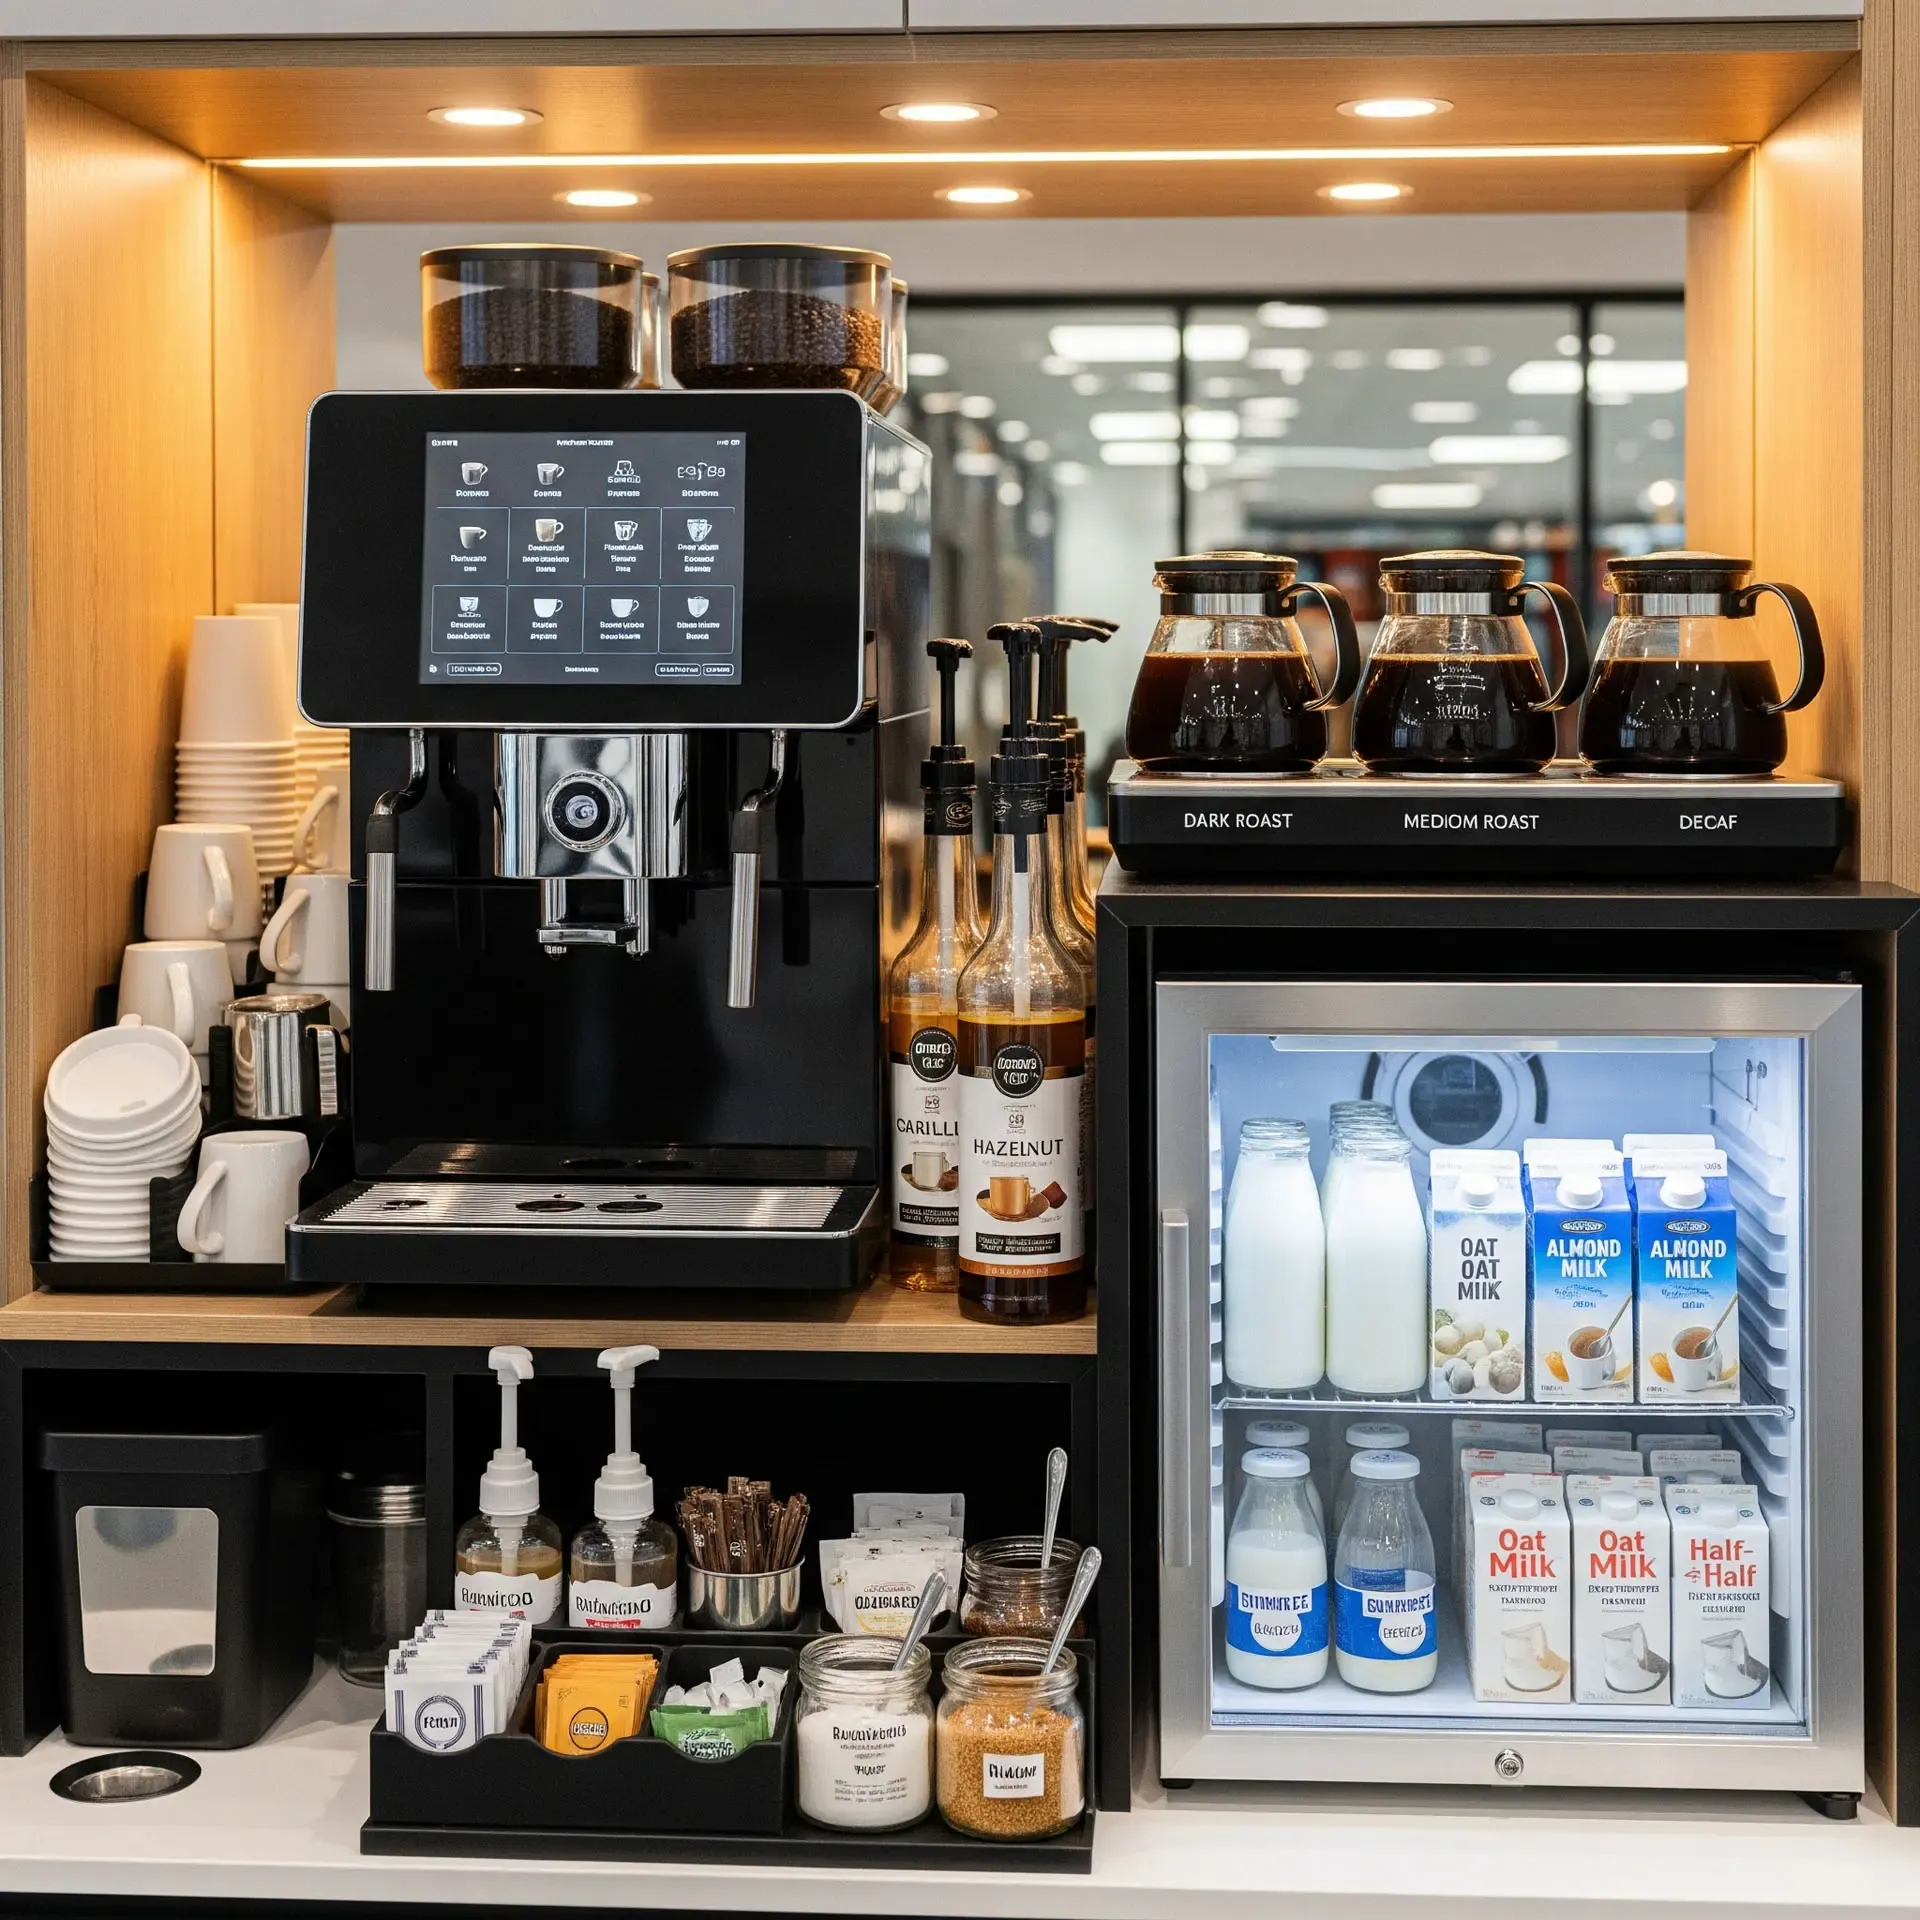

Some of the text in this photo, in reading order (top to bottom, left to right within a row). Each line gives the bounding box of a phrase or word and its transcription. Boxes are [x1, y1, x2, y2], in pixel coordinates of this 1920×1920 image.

[1184, 812, 1293, 829] DARK ROAST
[1483, 814, 1540, 830] ROAST
[1679, 814, 1738, 830] DECAF
[974, 1138, 1064, 1157] HAZELNUT
[1460, 1237, 1499, 1258] OAT
[1546, 1238, 1622, 1259] ALMOND
[1649, 1239, 1727, 1259] ALMOND
[1461, 1258, 1501, 1280] OAT
[1561, 1259, 1608, 1279] MILK
[1665, 1260, 1714, 1280] MILK
[1498, 1528, 1547, 1552] Oat
[1599, 1529, 1646, 1553] Oat
[1489, 1551, 1557, 1579] Milk
[1589, 1552, 1657, 1579] Milk
